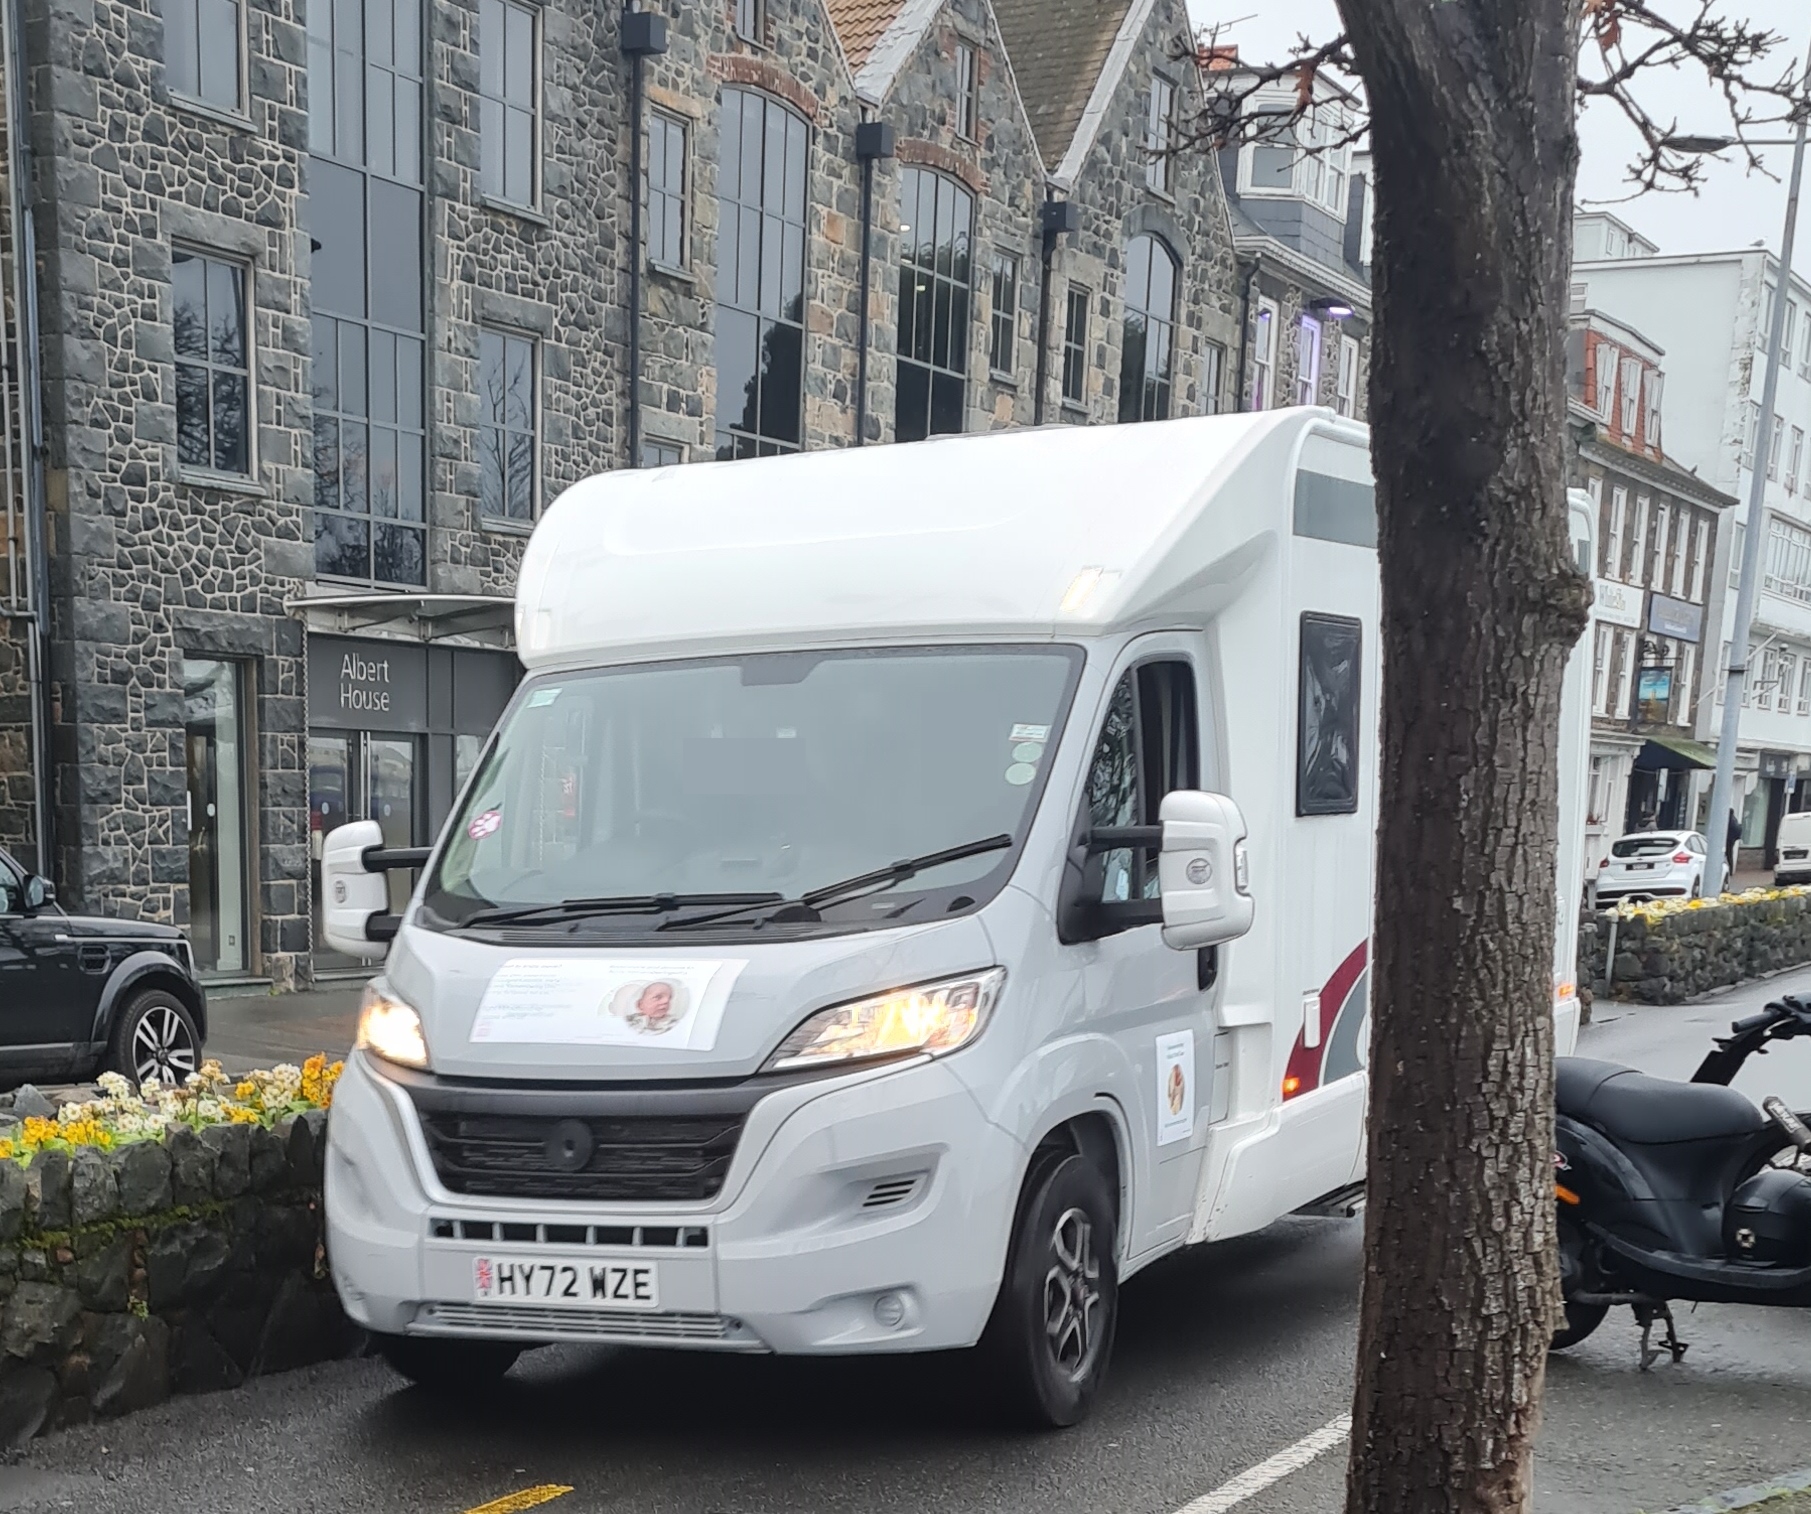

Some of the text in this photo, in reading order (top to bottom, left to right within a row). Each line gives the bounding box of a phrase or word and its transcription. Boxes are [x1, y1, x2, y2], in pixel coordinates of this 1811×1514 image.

[341, 652, 390, 683] Albert
[340, 682, 390, 711] House
[497, 1262, 651, 1300] HY72 WZE
